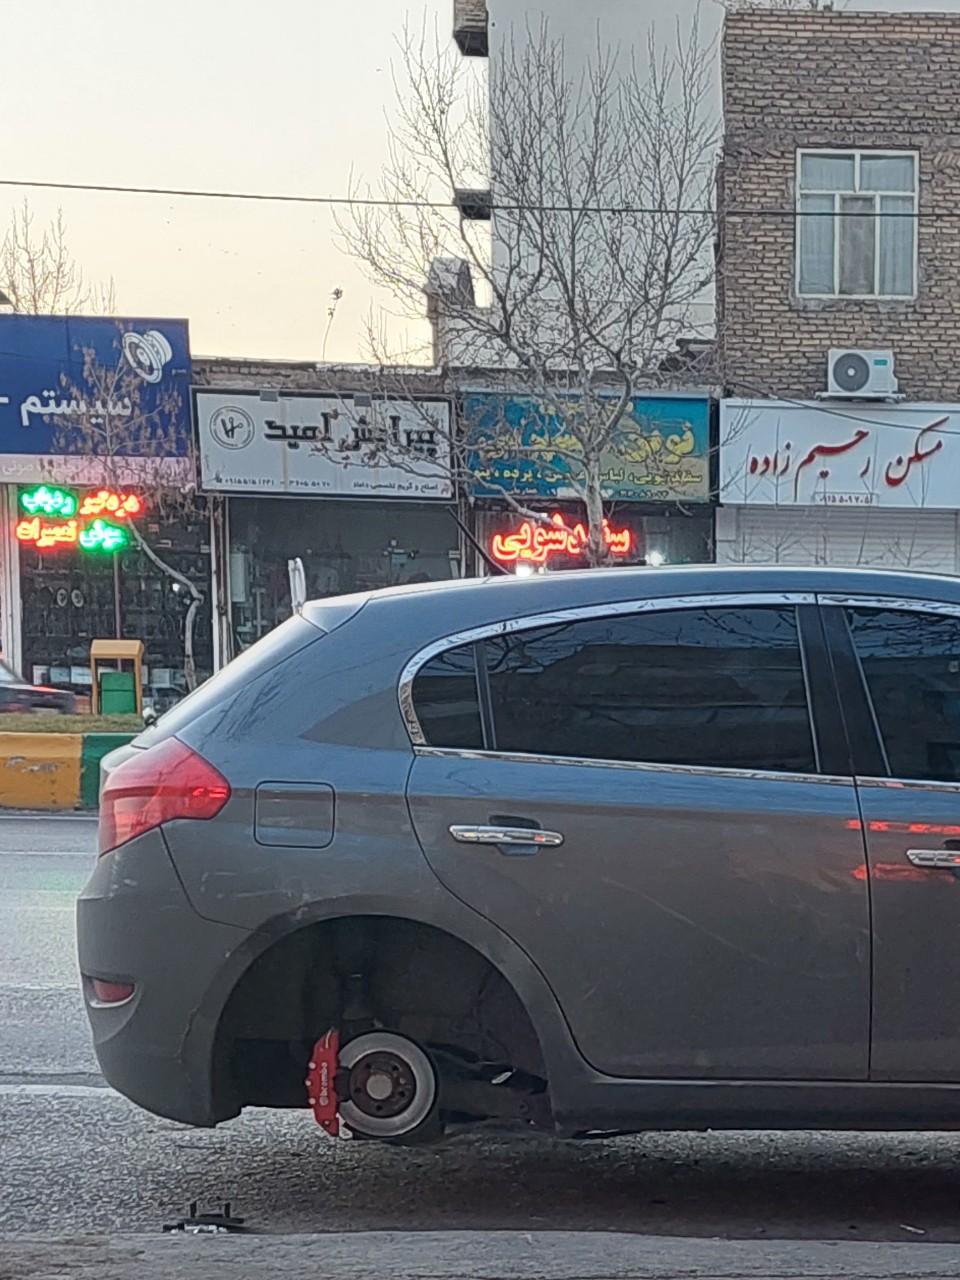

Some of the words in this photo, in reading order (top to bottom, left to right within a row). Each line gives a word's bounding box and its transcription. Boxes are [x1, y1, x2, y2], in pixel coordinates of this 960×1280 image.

[21, 390, 132, 426] سیستم
[264, 411, 334, 449] امید
[750, 441, 791, 476] زاده
[794, 430, 870, 502] رحیم
[885, 416, 950, 487] مسکن
